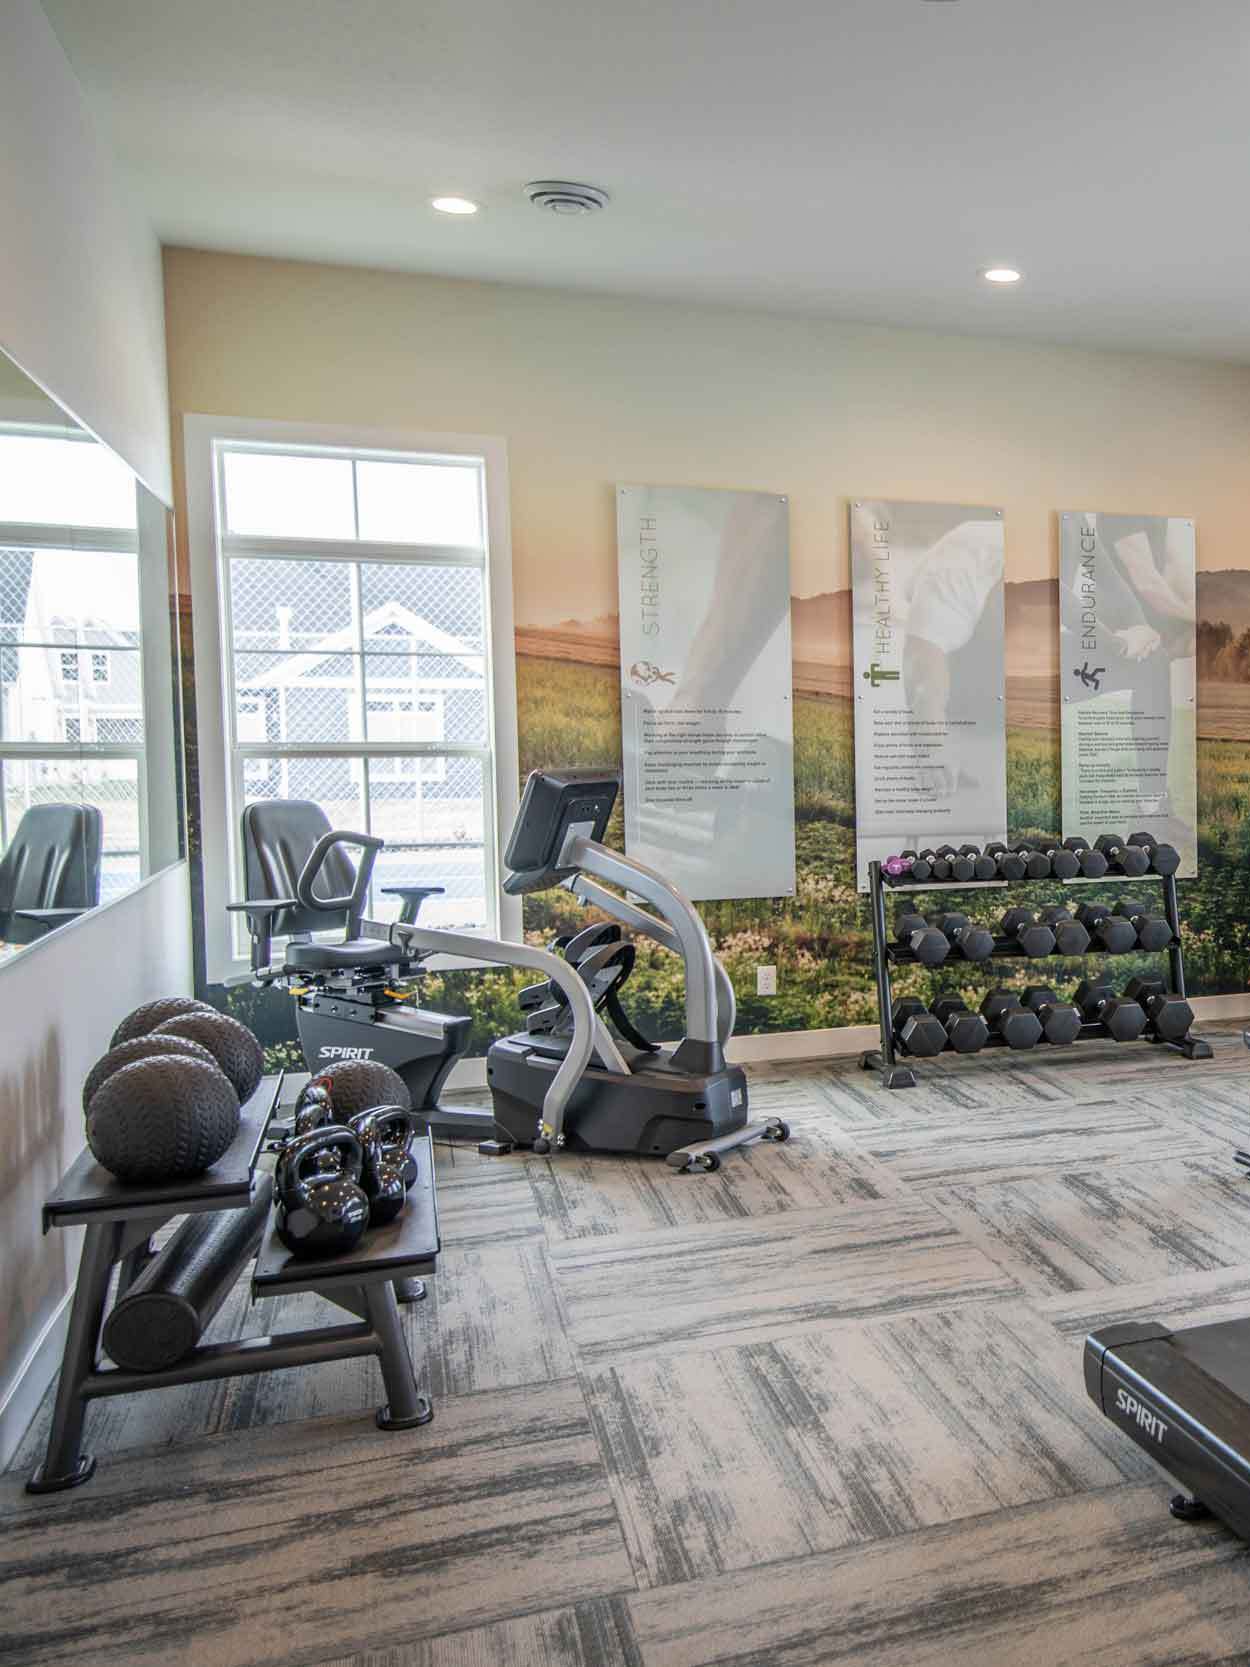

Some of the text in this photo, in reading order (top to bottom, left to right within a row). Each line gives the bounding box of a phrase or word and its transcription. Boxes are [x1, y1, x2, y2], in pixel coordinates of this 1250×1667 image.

[640, 517, 660, 636] STRENGTH
[873, 519, 891, 654] HEALTHY LIFE
[1080, 527, 1097, 650] ENDURANCE
[318, 1046, 374, 1060] SPIRIT
[1115, 1388, 1168, 1443] SPIRIT
